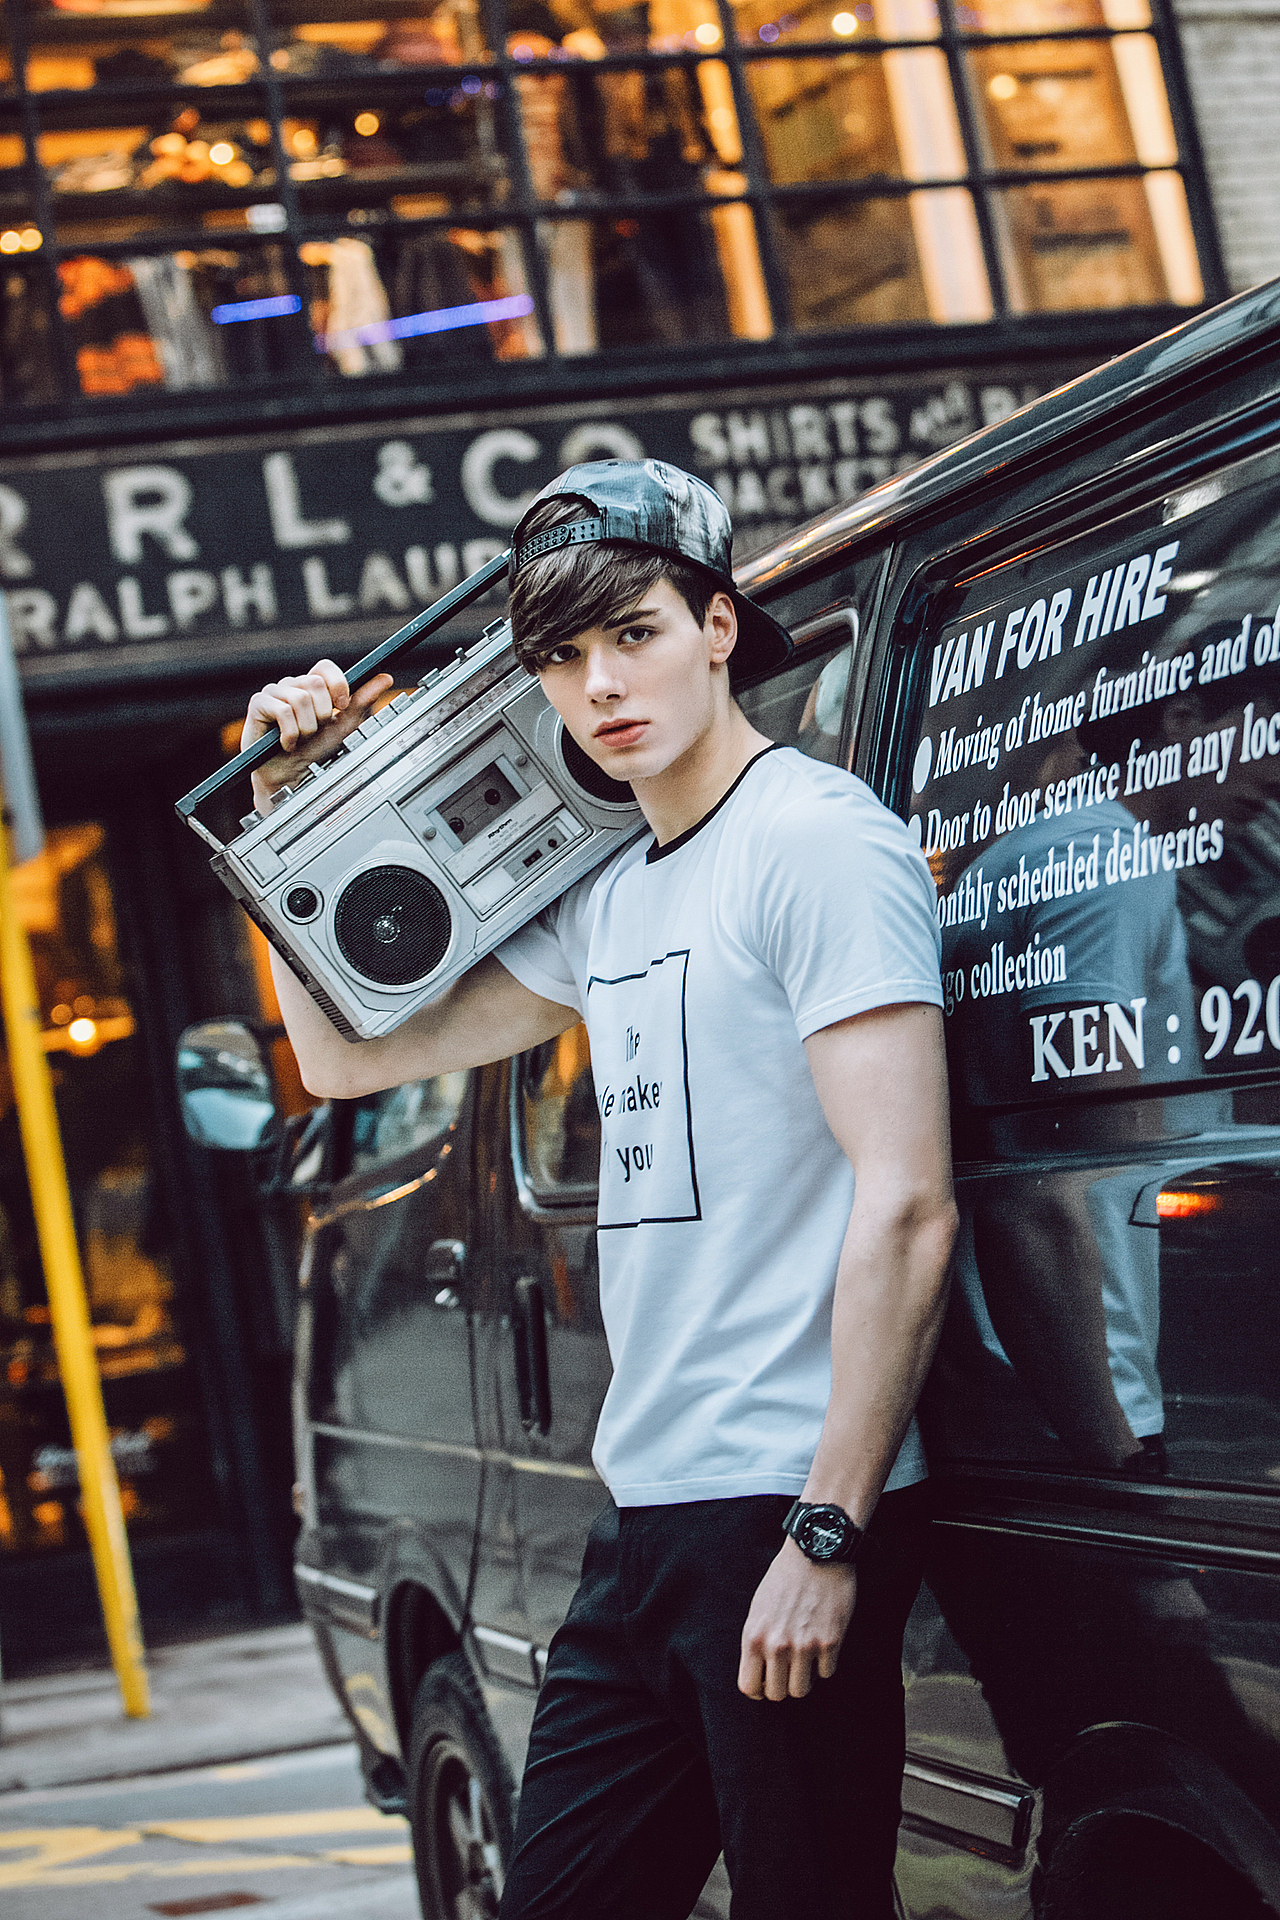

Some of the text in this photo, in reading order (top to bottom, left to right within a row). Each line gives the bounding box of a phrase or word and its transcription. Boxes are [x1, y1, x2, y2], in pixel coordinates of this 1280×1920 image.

[6, 562, 279, 652] RALPH
[929, 540, 1180, 708] VAN FOR HIRE
[933, 715, 1003, 780] Moving
[1005, 692, 1032, 752] of
[1027, 691, 1087, 744] home
[1089, 651, 1194, 722] furniture
[1198, 613, 1253, 685] and
[925, 809, 970, 858] Door
[972, 799, 992, 844] to
[995, 782, 1040, 836] door
[1043, 753, 1121, 820] service
[1124, 739, 1182, 796] from
[1187, 726, 1237, 785] any
[935, 807, 1225, 931] onthly scheduled deliveries
[971, 933, 1067, 1000] collection
[1029, 997, 1147, 1083] KEN
